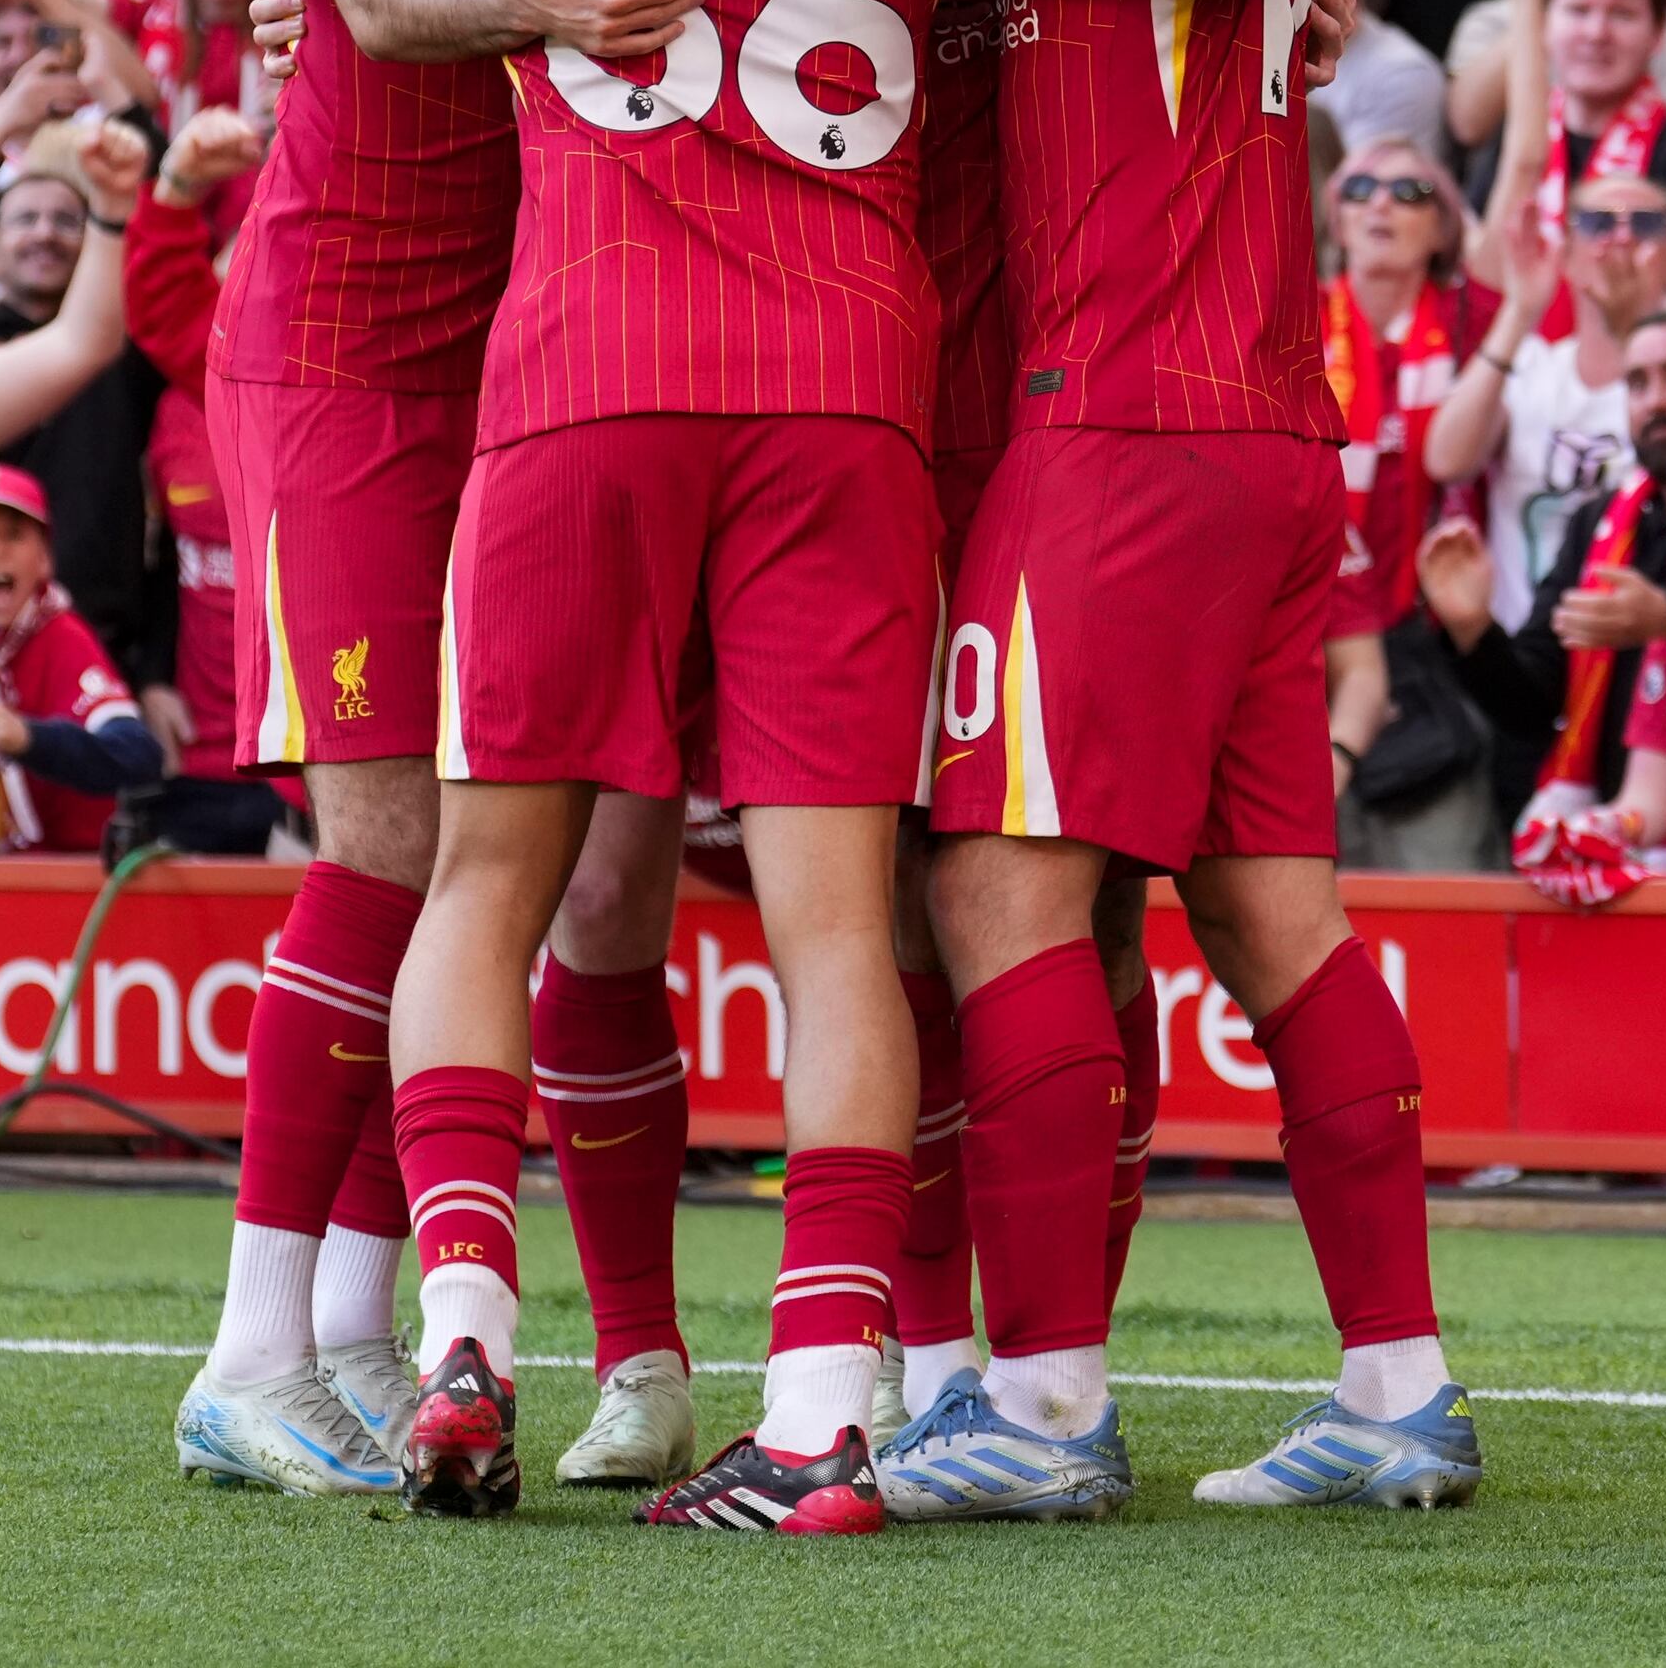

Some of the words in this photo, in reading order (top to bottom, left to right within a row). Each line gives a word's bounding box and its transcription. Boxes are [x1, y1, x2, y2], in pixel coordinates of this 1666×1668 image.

[944, 622, 998, 743] 0
[438, 1242, 484, 1261] LFC
[1093, 1443, 1117, 1460] COPA
